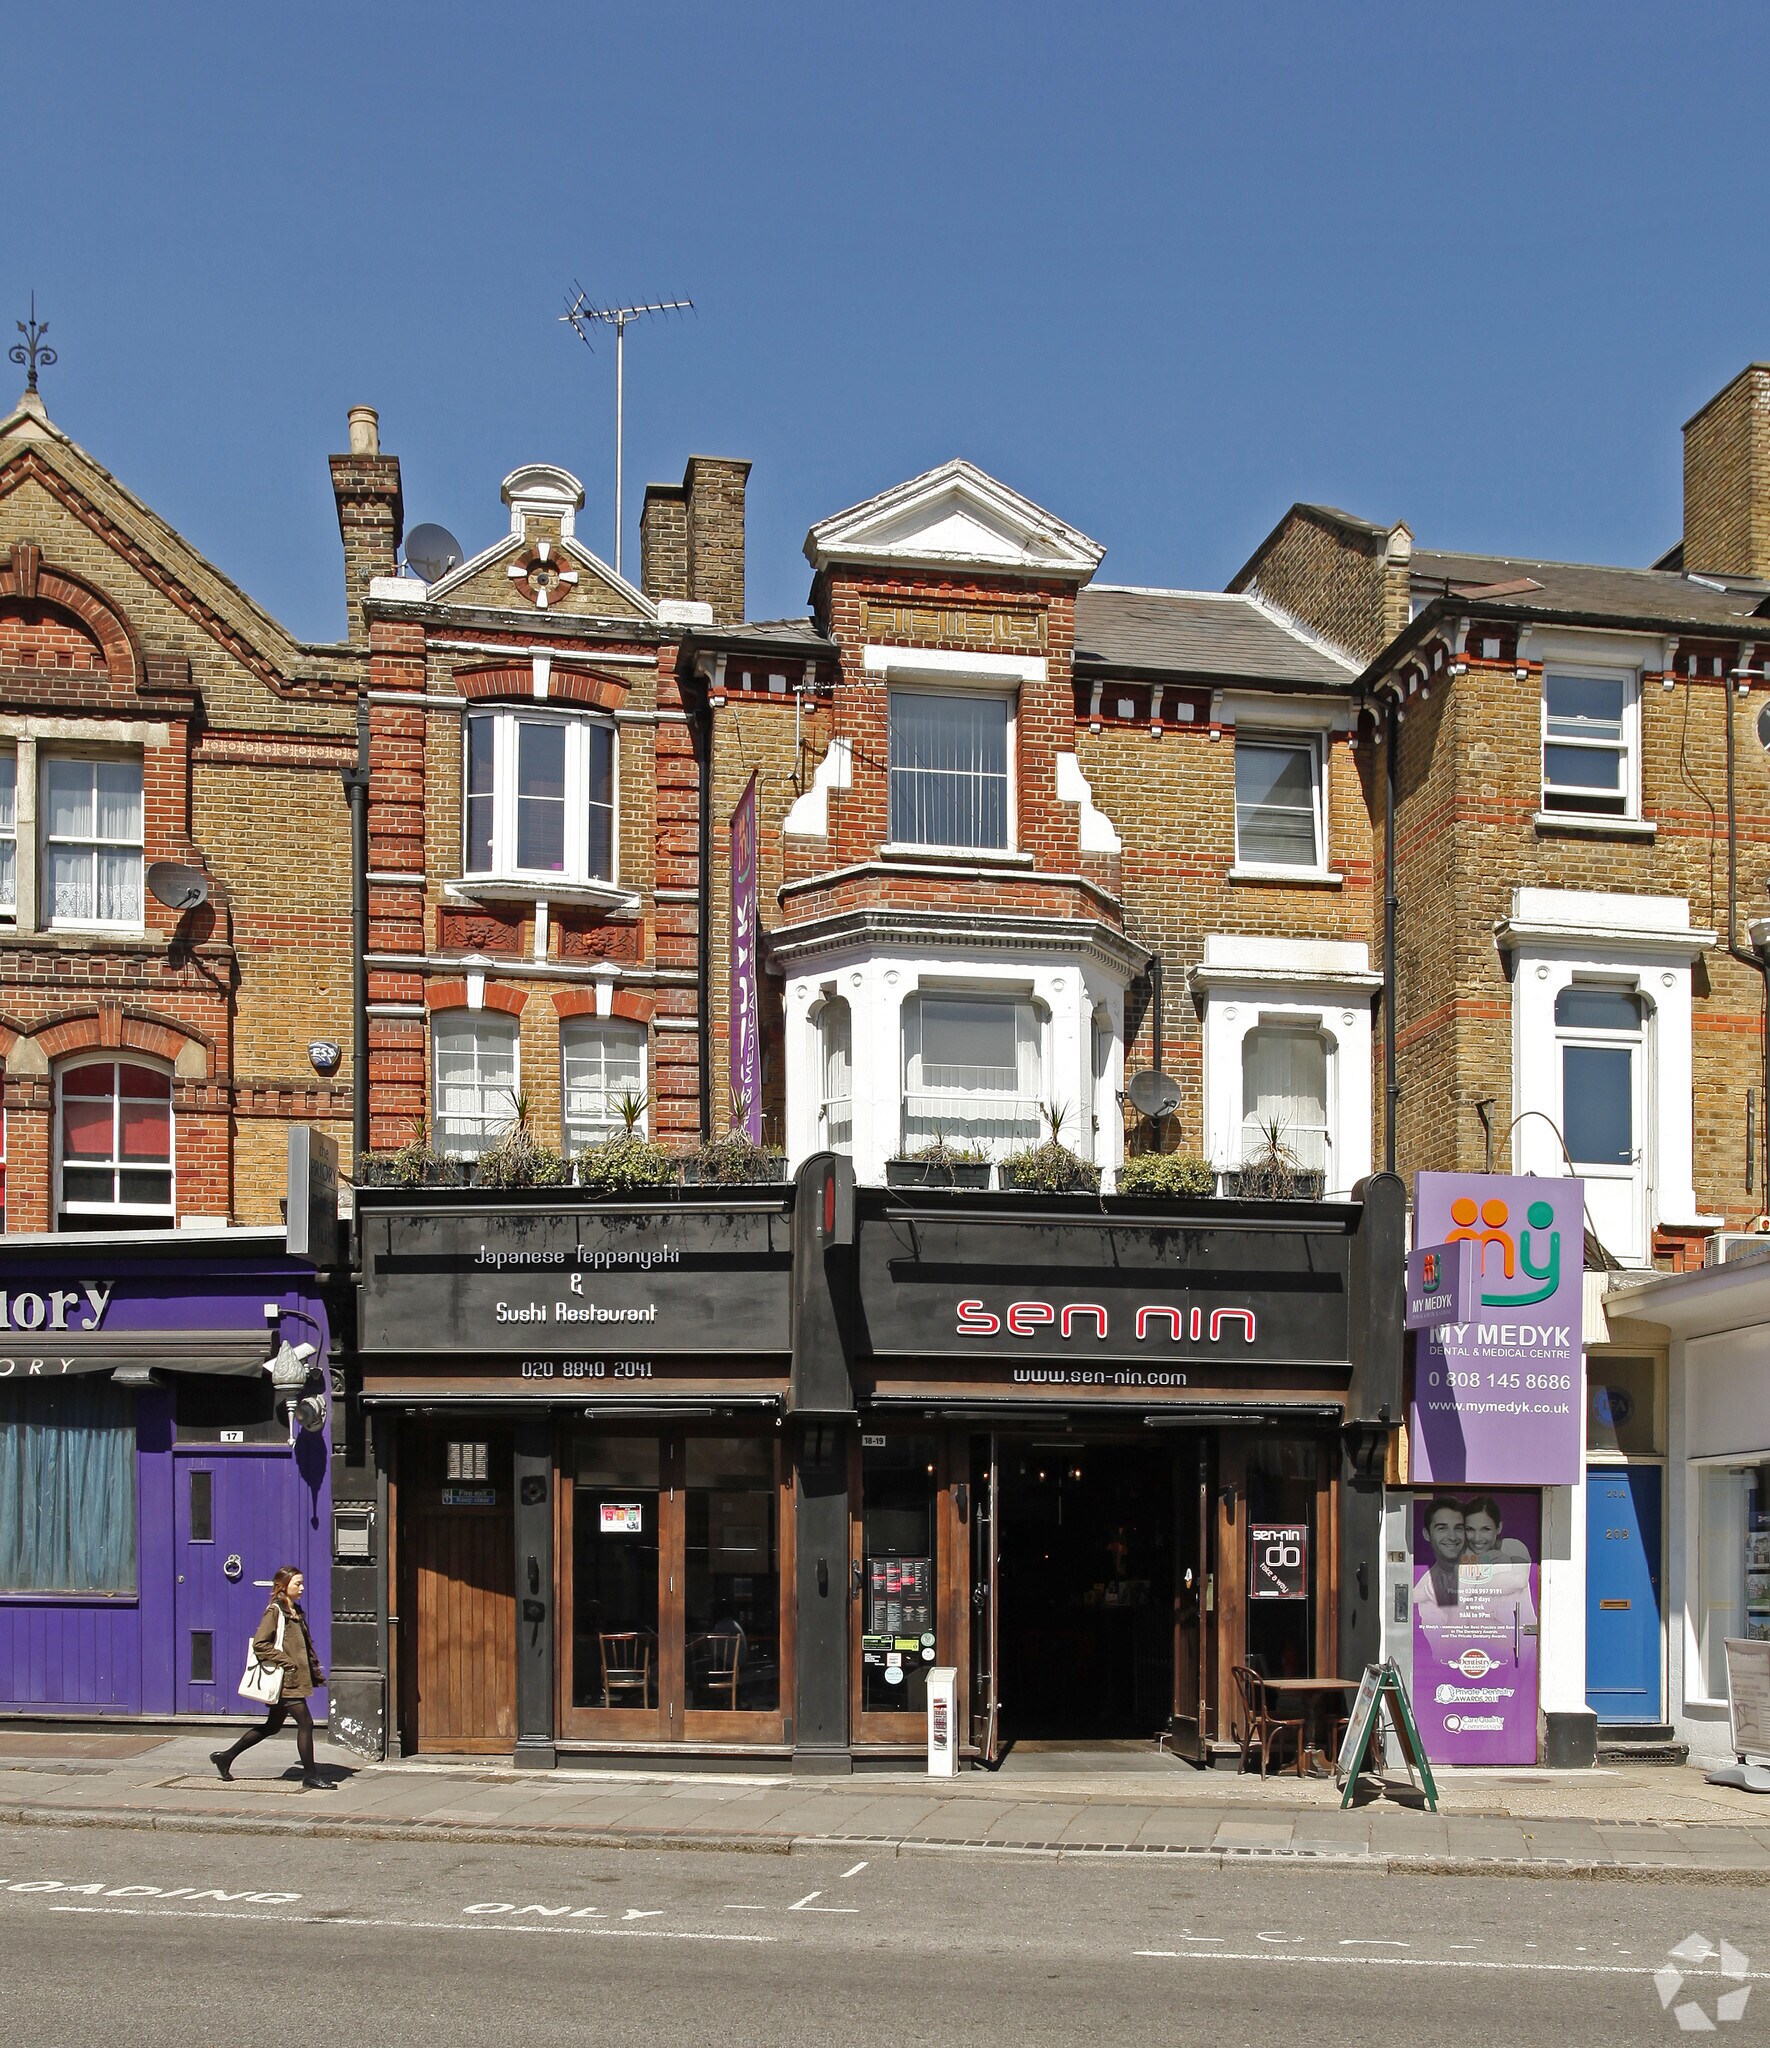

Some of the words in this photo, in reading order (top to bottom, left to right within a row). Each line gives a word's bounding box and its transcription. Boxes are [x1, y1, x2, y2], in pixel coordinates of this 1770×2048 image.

[311, 1047, 337, 1057] ESS
[310, 1158, 337, 1185] PRIORY
[474, 1245, 565, 1269] Japanese
[577, 1245, 680, 1270] Teppanyaki
[571, 1273, 583, 1296] &
[496, 1302, 547, 1322] Sushi
[555, 1302, 658, 1323] Restaurant
[1412, 1299, 1424, 1313] MY
[1425, 1294, 1453, 1311] MEDYK
[1135, 1305, 1256, 1343] nin
[1429, 1325, 1467, 1345] MY
[1478, 1325, 1570, 1347] MEDYK
[1429, 1346, 1470, 1357] DENTAL
[1472, 1347, 1480, 1357] &
[1482, 1347, 1527, 1358] MEDICAL
[1530, 1348, 1570, 1359] CENTRE
[521, 1361, 554, 1378] 020
[562, 1361, 605, 1378] 8840
[614, 1361, 653, 1378] 2041
[1013, 1368, 1187, 1386] www.sen-nin.com
[1446, 1372, 1480, 1388] 808
[1486, 1373, 1520, 1389] 145
[1525, 1373, 1571, 1390] 8686
[1429, 1401, 1569, 1415] www.mymedyk.co.uk
[864, 1436, 885, 1446] 18-19
[1253, 1530, 1300, 1541] sen-nin
[1389, 1552, 1405, 1562] 19
[1460, 1659, 1489, 1667] Dentistry
[1456, 1688, 1480, 1696] Private
[1482, 1689, 1513, 1697] Dentistry
[462, 1902, 664, 1920] ONLY
